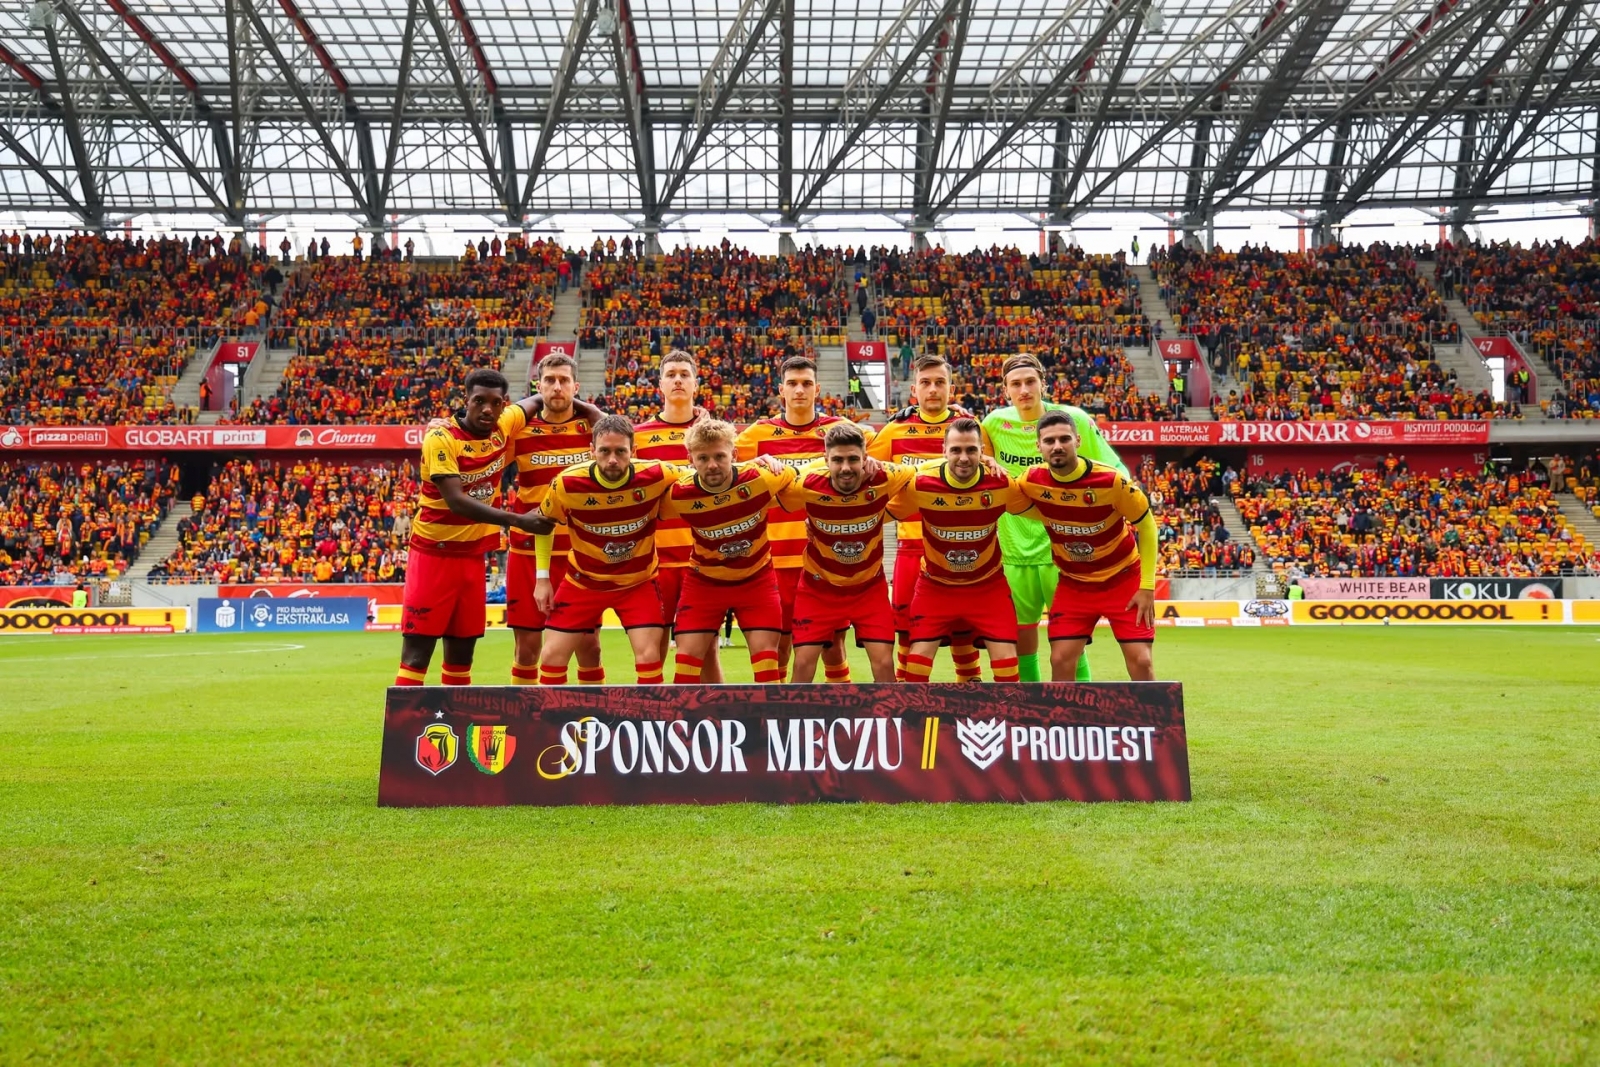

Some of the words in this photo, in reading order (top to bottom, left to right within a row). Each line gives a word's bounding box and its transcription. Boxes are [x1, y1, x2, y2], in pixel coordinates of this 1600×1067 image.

[237, 346, 249, 358] 51
[859, 345, 874, 357] 49
[1166, 343, 1182, 355] 48
[1479, 340, 1493, 352] 47
[1100, 424, 1154, 442] aizen
[1241, 422, 1351, 443] PRONAR
[1403, 423, 1441, 433] INSTYTUT
[36, 432, 68, 443] pizza
[69, 431, 102, 443] pelati
[125, 430, 213, 446] GLOBART
[222, 430, 256, 443] print
[317, 429, 376, 446] Chorten
[1160, 434, 1210, 442] BUDOWLANE
[1251, 454, 1264, 466] 16
[583, 516, 649, 535] SUPERBET
[697, 512, 761, 539] SUPERBET
[815, 515, 879, 534] SUPERBET
[1049, 521, 1106, 535] UPERBET
[1339, 582, 1385, 593] WHITE
[1389, 582, 1427, 593] BEAR
[1443, 582, 1511, 599] KOKU
[276, 613, 350, 625] EKSTRAKLASA
[559, 719, 748, 776] SPONSOR
[766, 717, 902, 772] MECZU
[1011, 725, 1155, 762] PROUDEST
